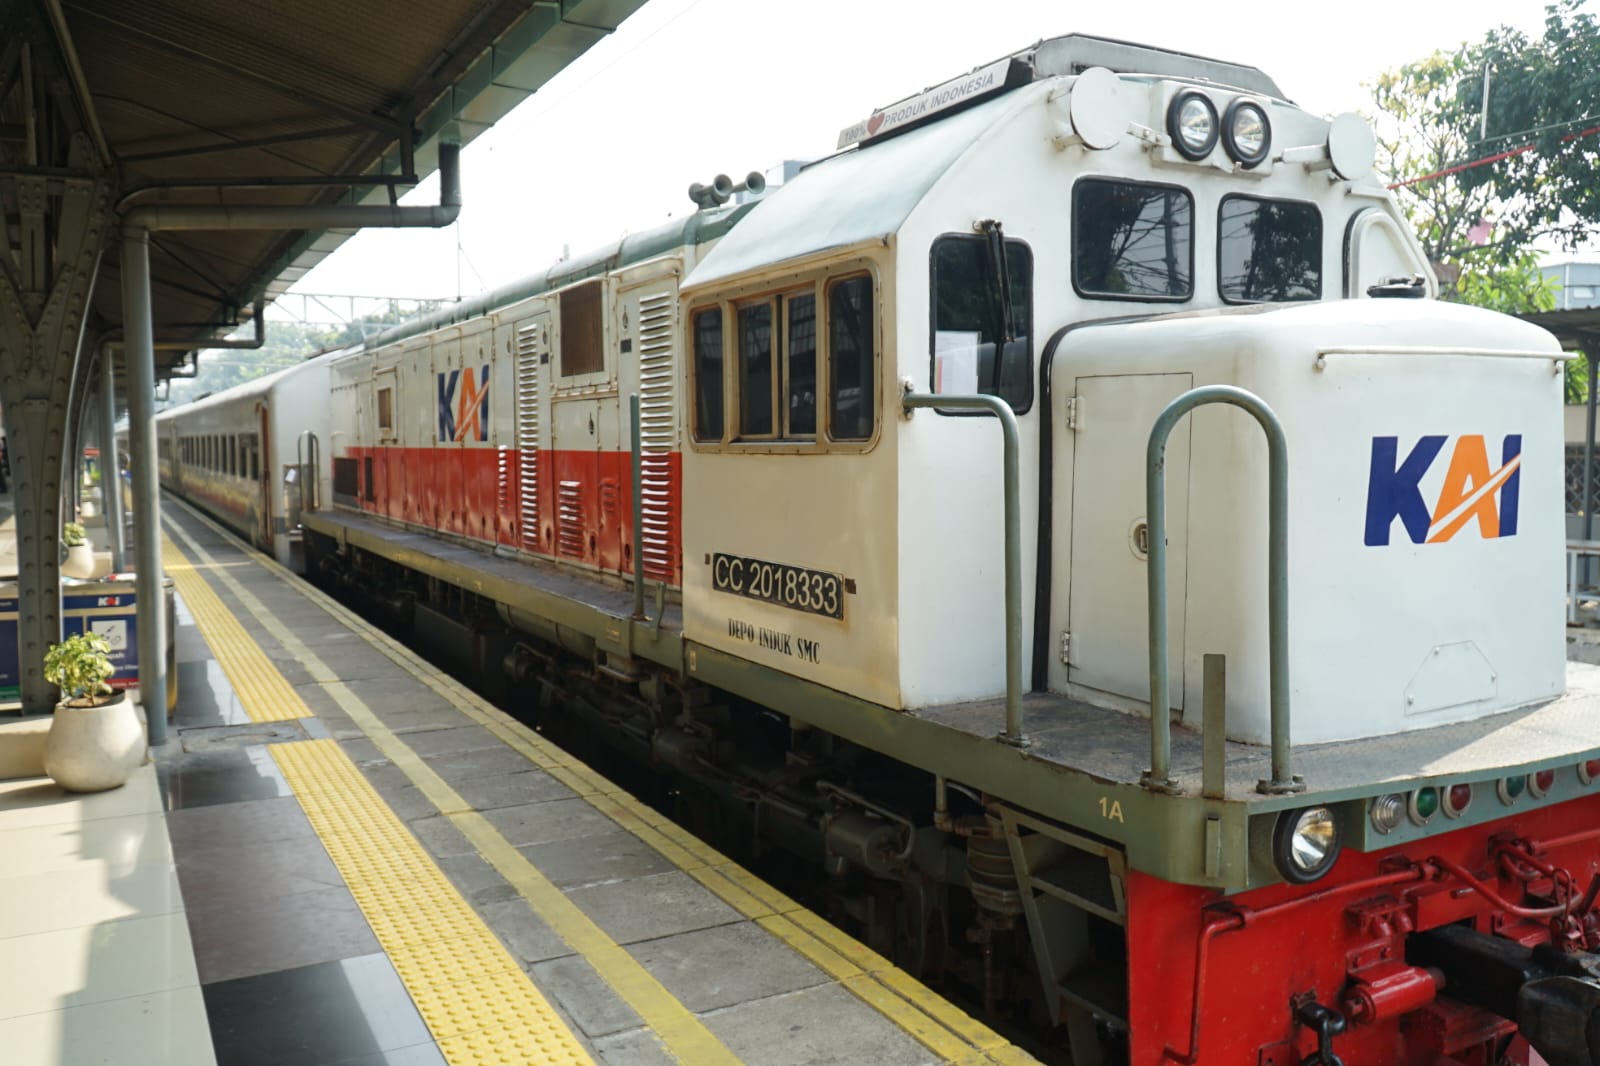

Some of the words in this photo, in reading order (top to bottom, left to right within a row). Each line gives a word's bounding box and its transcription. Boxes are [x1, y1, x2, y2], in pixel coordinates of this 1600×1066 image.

[845, 125, 866, 141] 100%
[883, 101, 928, 126] PRODUK
[932, 73, 994, 107] INDONESIA
[438, 364, 489, 442] KAI
[1364, 434, 1522, 547] KAI
[715, 556, 744, 591] CC
[748, 562, 838, 614] 2018333
[728, 618, 755, 641] DEPO
[759, 628, 792, 656] INDUK
[797, 637, 820, 664] SMC
[1099, 796, 1124, 823] 1A
